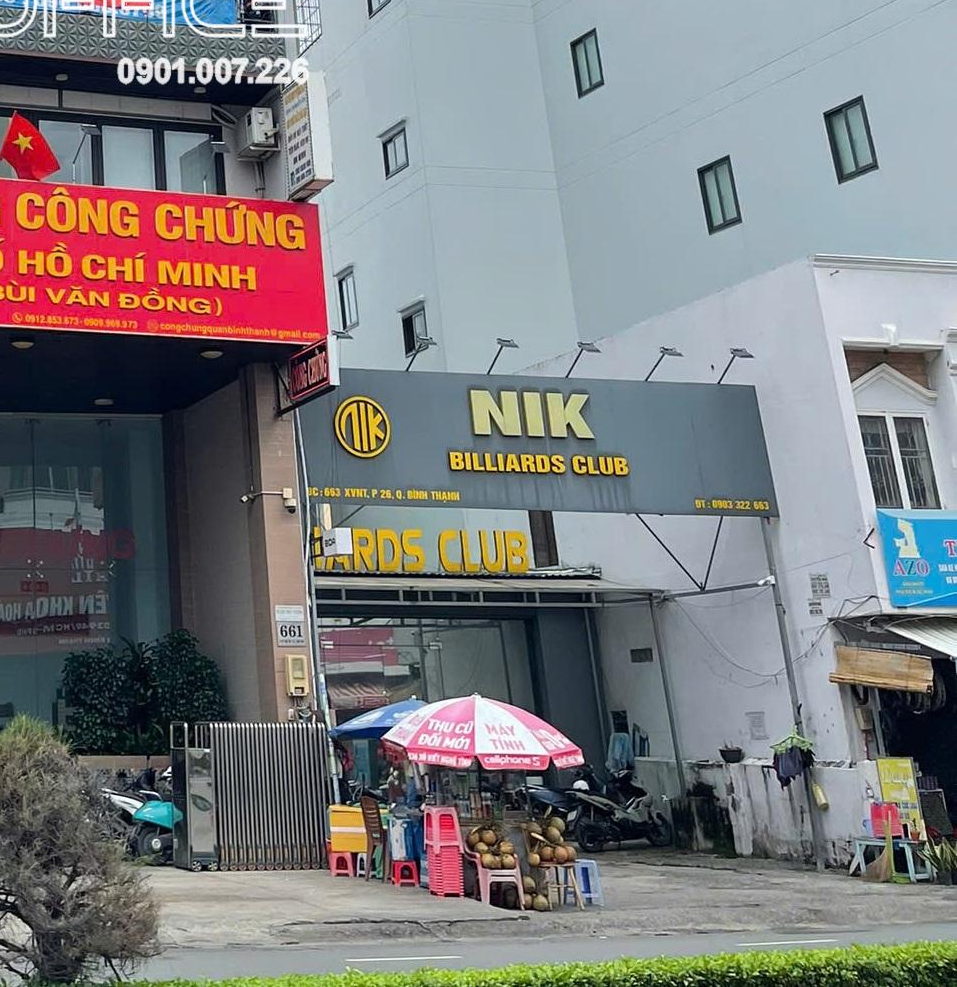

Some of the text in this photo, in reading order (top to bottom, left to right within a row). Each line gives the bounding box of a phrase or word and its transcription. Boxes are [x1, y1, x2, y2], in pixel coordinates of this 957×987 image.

[16, 187, 139, 238] CÔNG
[155, 200, 307, 250] CHỨNG
[18, 242, 72, 278] HỒ
[82, 252, 146, 284] CHÍ
[157, 260, 257, 291] MINH
[45, 286, 110, 308] VĂN
[118, 287, 224, 316] ĐỒNG)
[470, 389, 595, 439] NIK
[449, 451, 629, 475] BILLIARDS CLUB
[438, 529, 530, 574] CLUB
[893, 558, 931, 577] AZO
[280, 625, 303, 638] 661
[427, 718, 454, 733] THU
[455, 720, 474, 734] CŨ
[443, 735, 471, 750] MỚI
